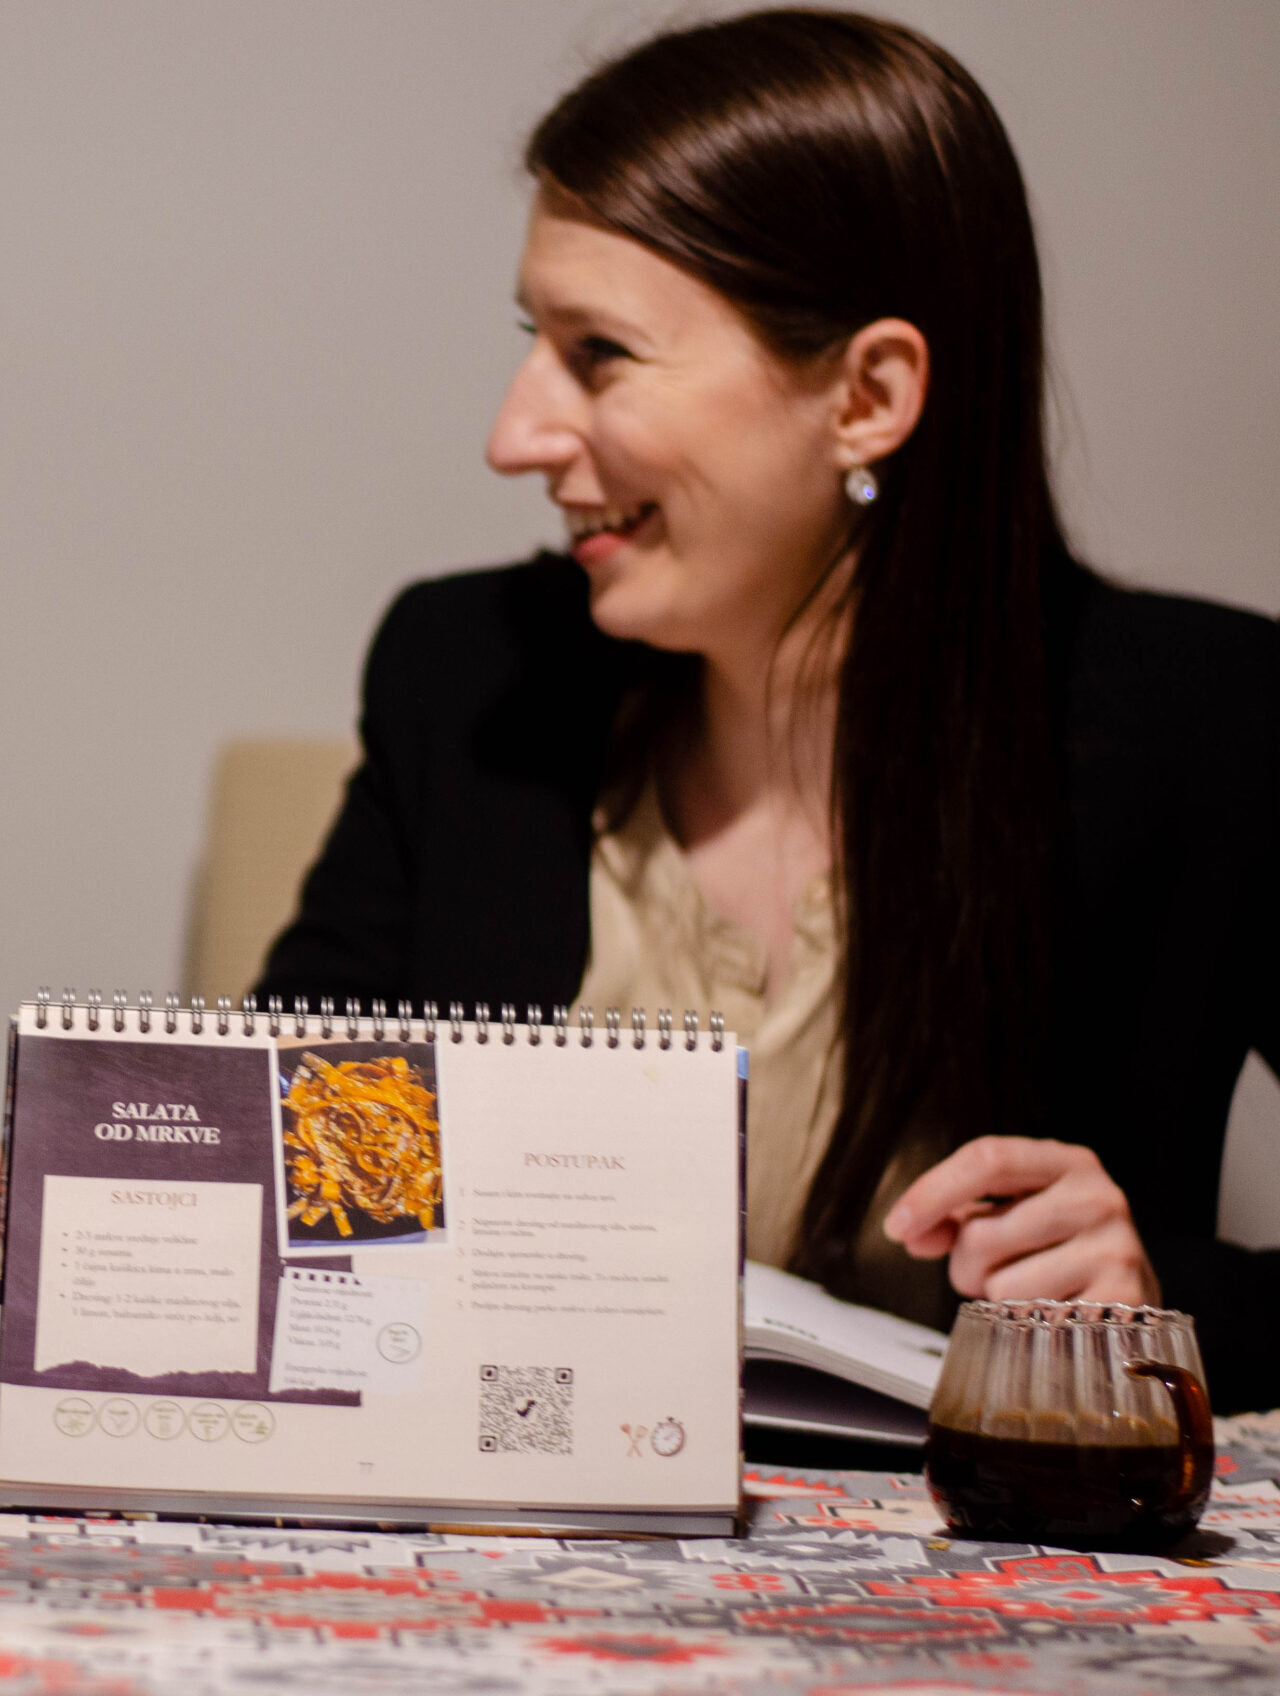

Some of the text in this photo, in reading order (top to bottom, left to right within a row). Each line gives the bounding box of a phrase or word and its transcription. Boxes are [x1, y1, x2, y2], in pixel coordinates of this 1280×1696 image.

[111, 1101, 201, 1122] SALATA
[94, 1122, 221, 1144] OD MRKVE
[523, 1152, 626, 1170] POSTUPAK
[111, 1190, 198, 1209] SASTOJCI
